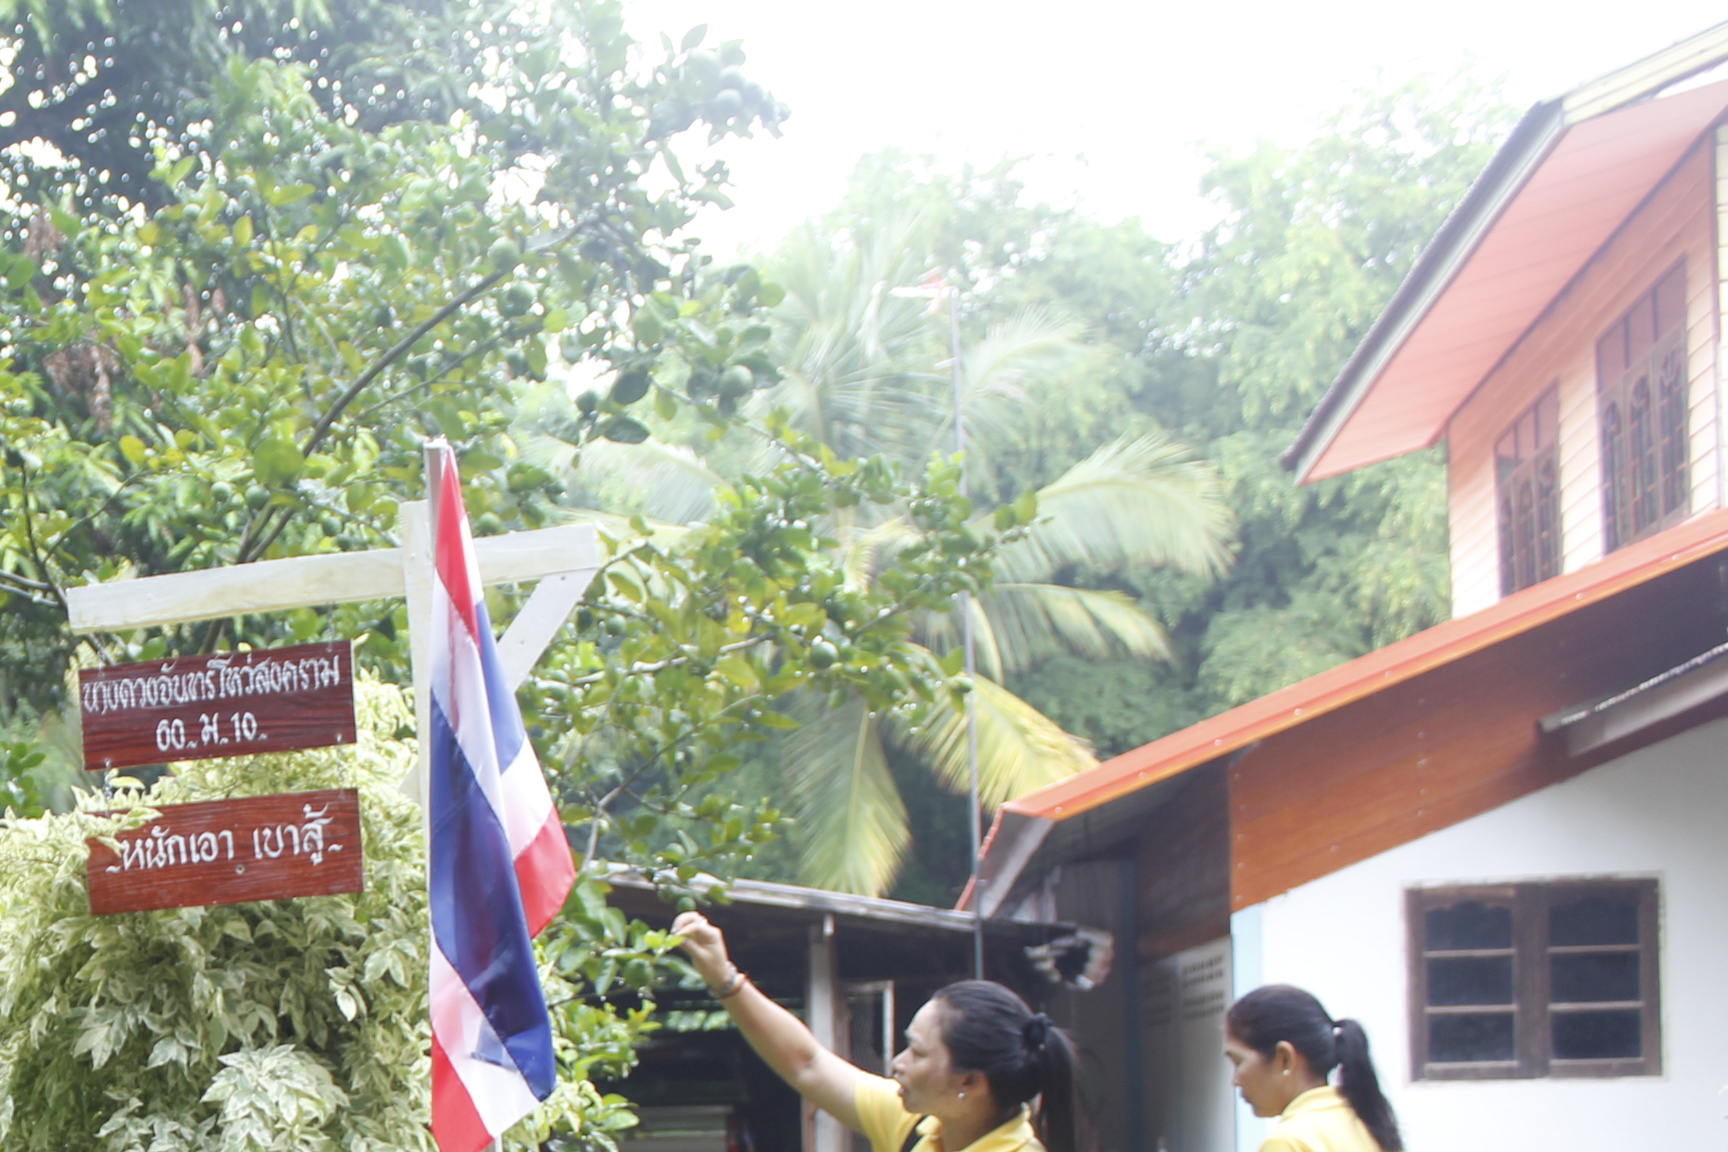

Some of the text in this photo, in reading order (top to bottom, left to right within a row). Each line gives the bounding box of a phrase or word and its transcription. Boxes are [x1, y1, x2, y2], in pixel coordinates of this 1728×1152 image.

[121, 802, 334, 871] หนักเอา เบาสู้
